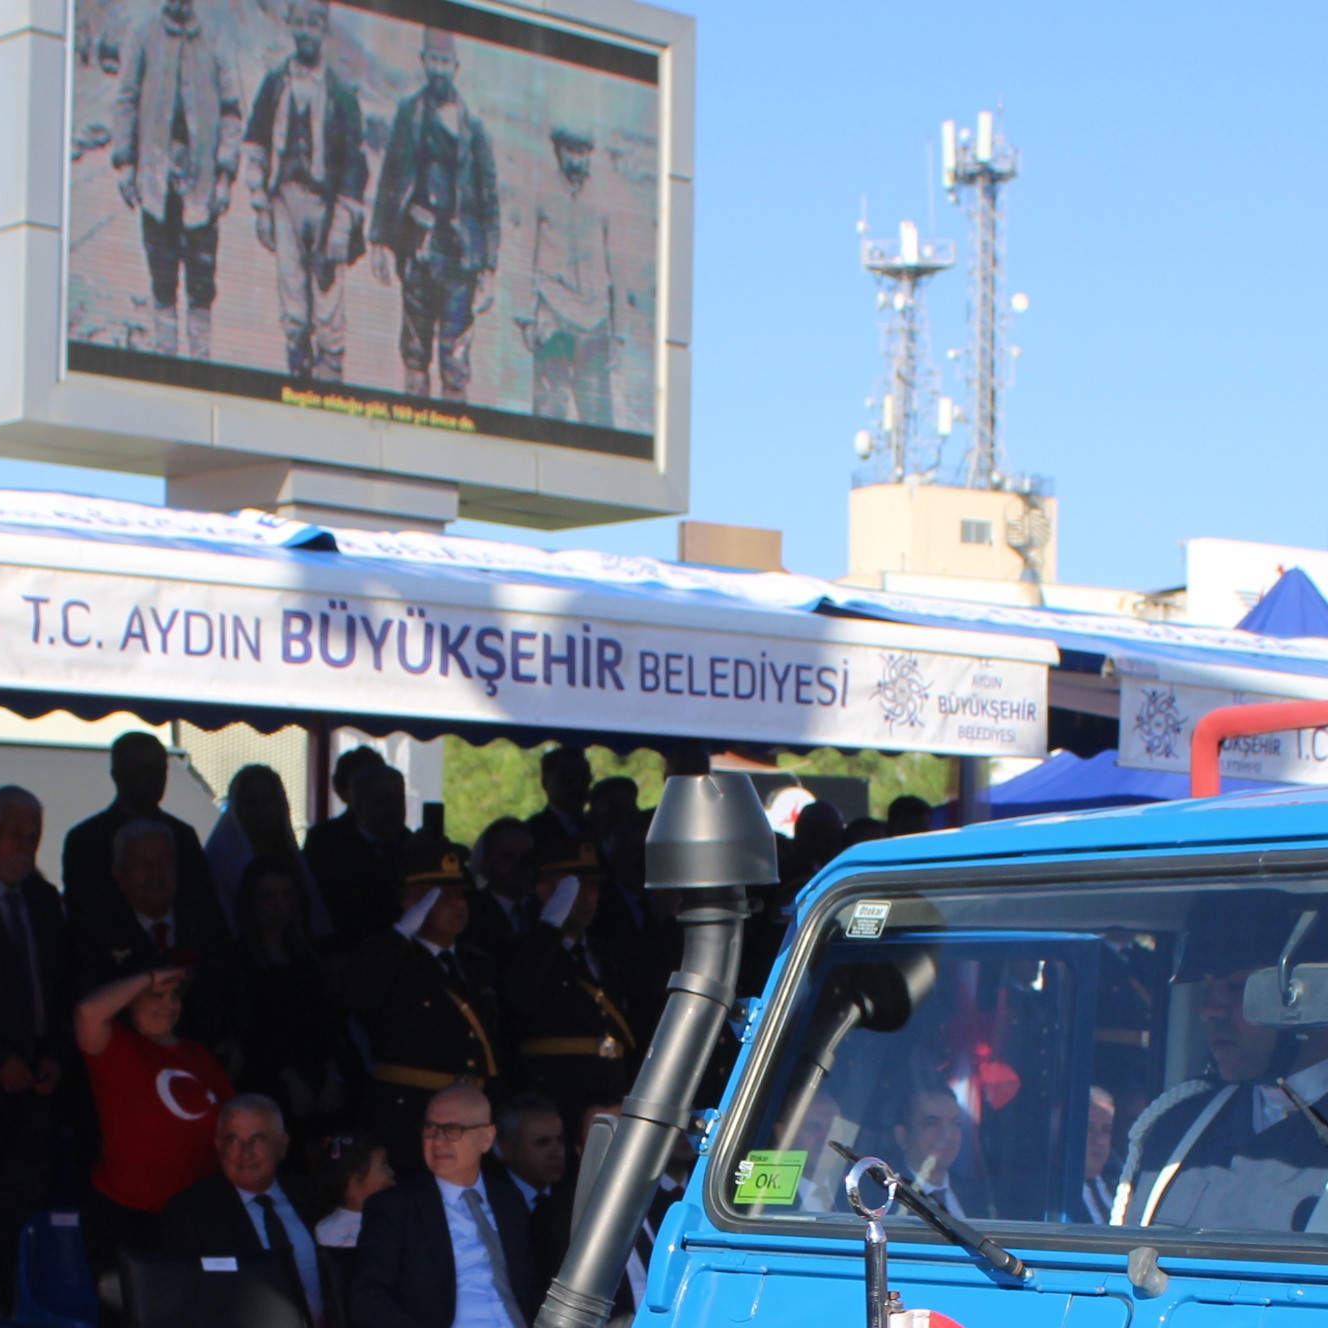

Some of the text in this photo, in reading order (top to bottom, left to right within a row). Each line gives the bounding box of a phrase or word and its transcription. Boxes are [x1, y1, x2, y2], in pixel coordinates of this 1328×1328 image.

[22, 594, 850, 708] T.C. AYDIN BÜYÜKŞEHİR BELEDİYESİ
[937, 692, 1037, 724] BÜYÜKŞEHİR
[957, 724, 1017, 743] BELEDİYESİ
